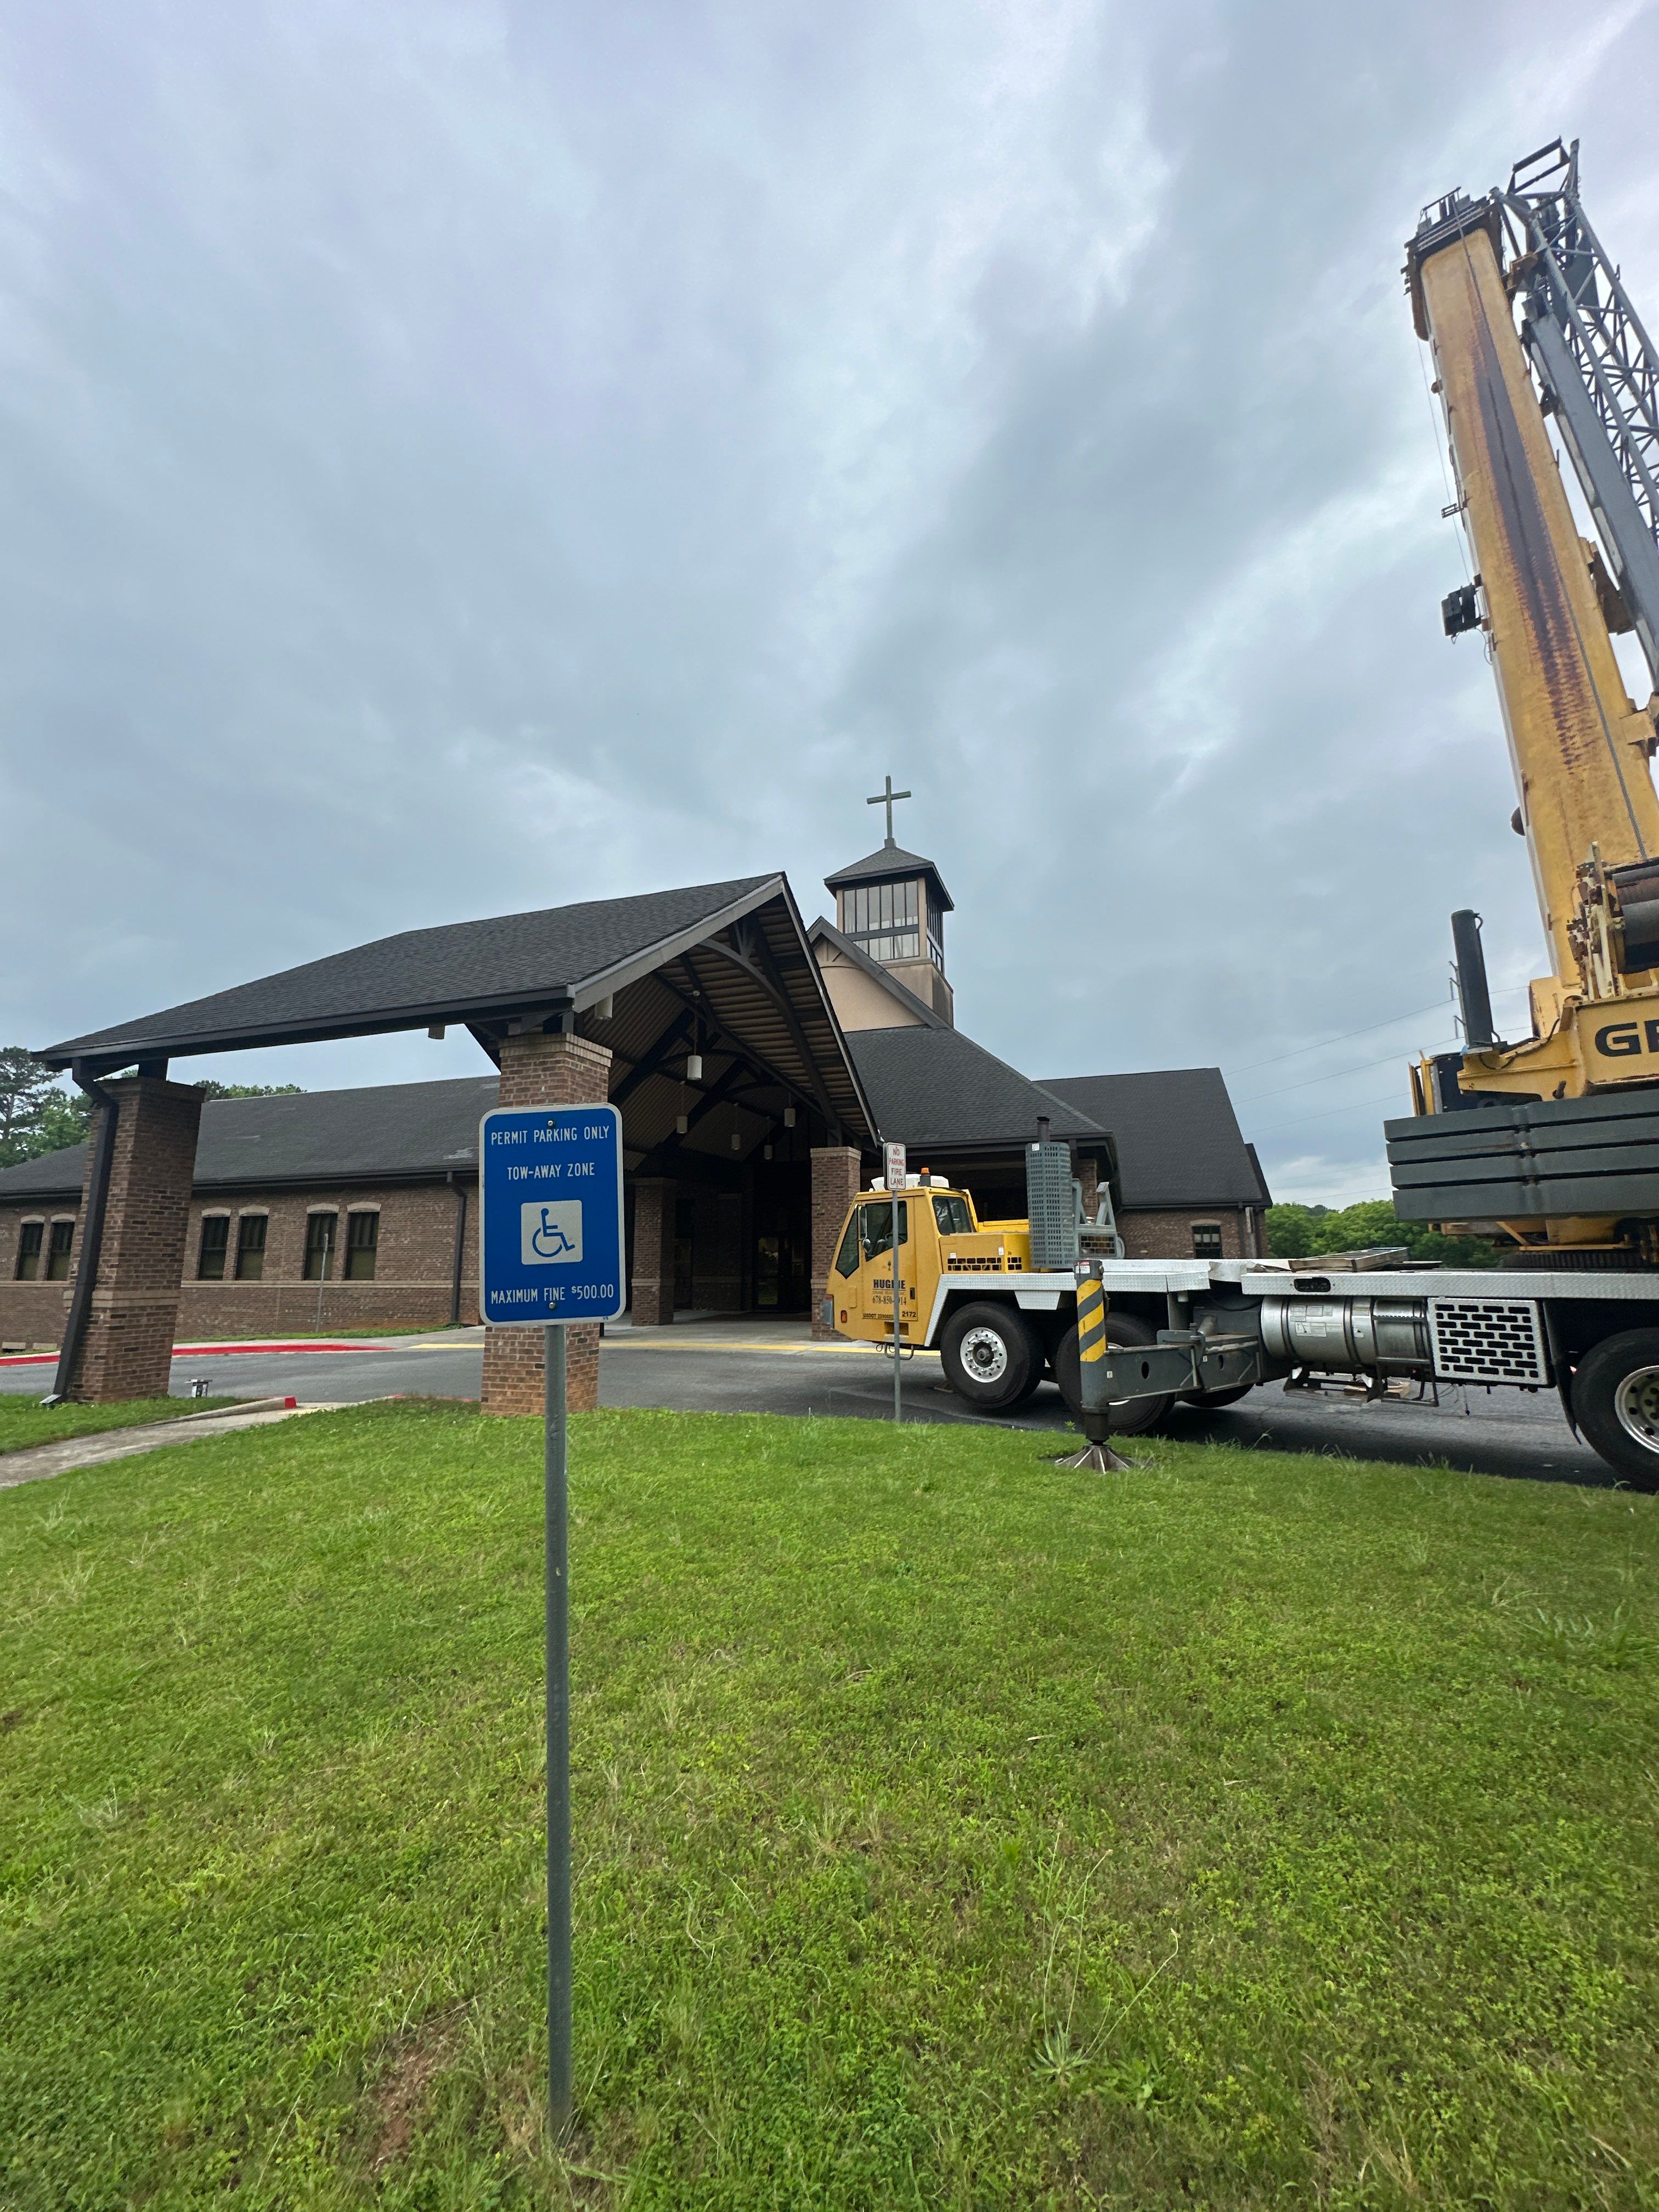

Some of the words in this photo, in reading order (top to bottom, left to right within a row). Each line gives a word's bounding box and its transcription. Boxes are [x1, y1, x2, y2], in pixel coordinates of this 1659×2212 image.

[491, 1130, 527, 1146] PERMIT
[534, 1127, 577, 1143] PARKING
[584, 1126, 610, 1140] ONLY
[889, 1158, 904, 1166] PARKING
[507, 1164, 562, 1180] TOW-AWAY
[567, 1163, 595, 1177] ZONE
[891, 1167, 902, 1176] FIRE
[890, 1177, 904, 1186] LANE
[491, 1289, 538, 1305] MAXIMUM
[544, 1286, 566, 1301] FINE
[571, 1284, 614, 1300] $500.00
